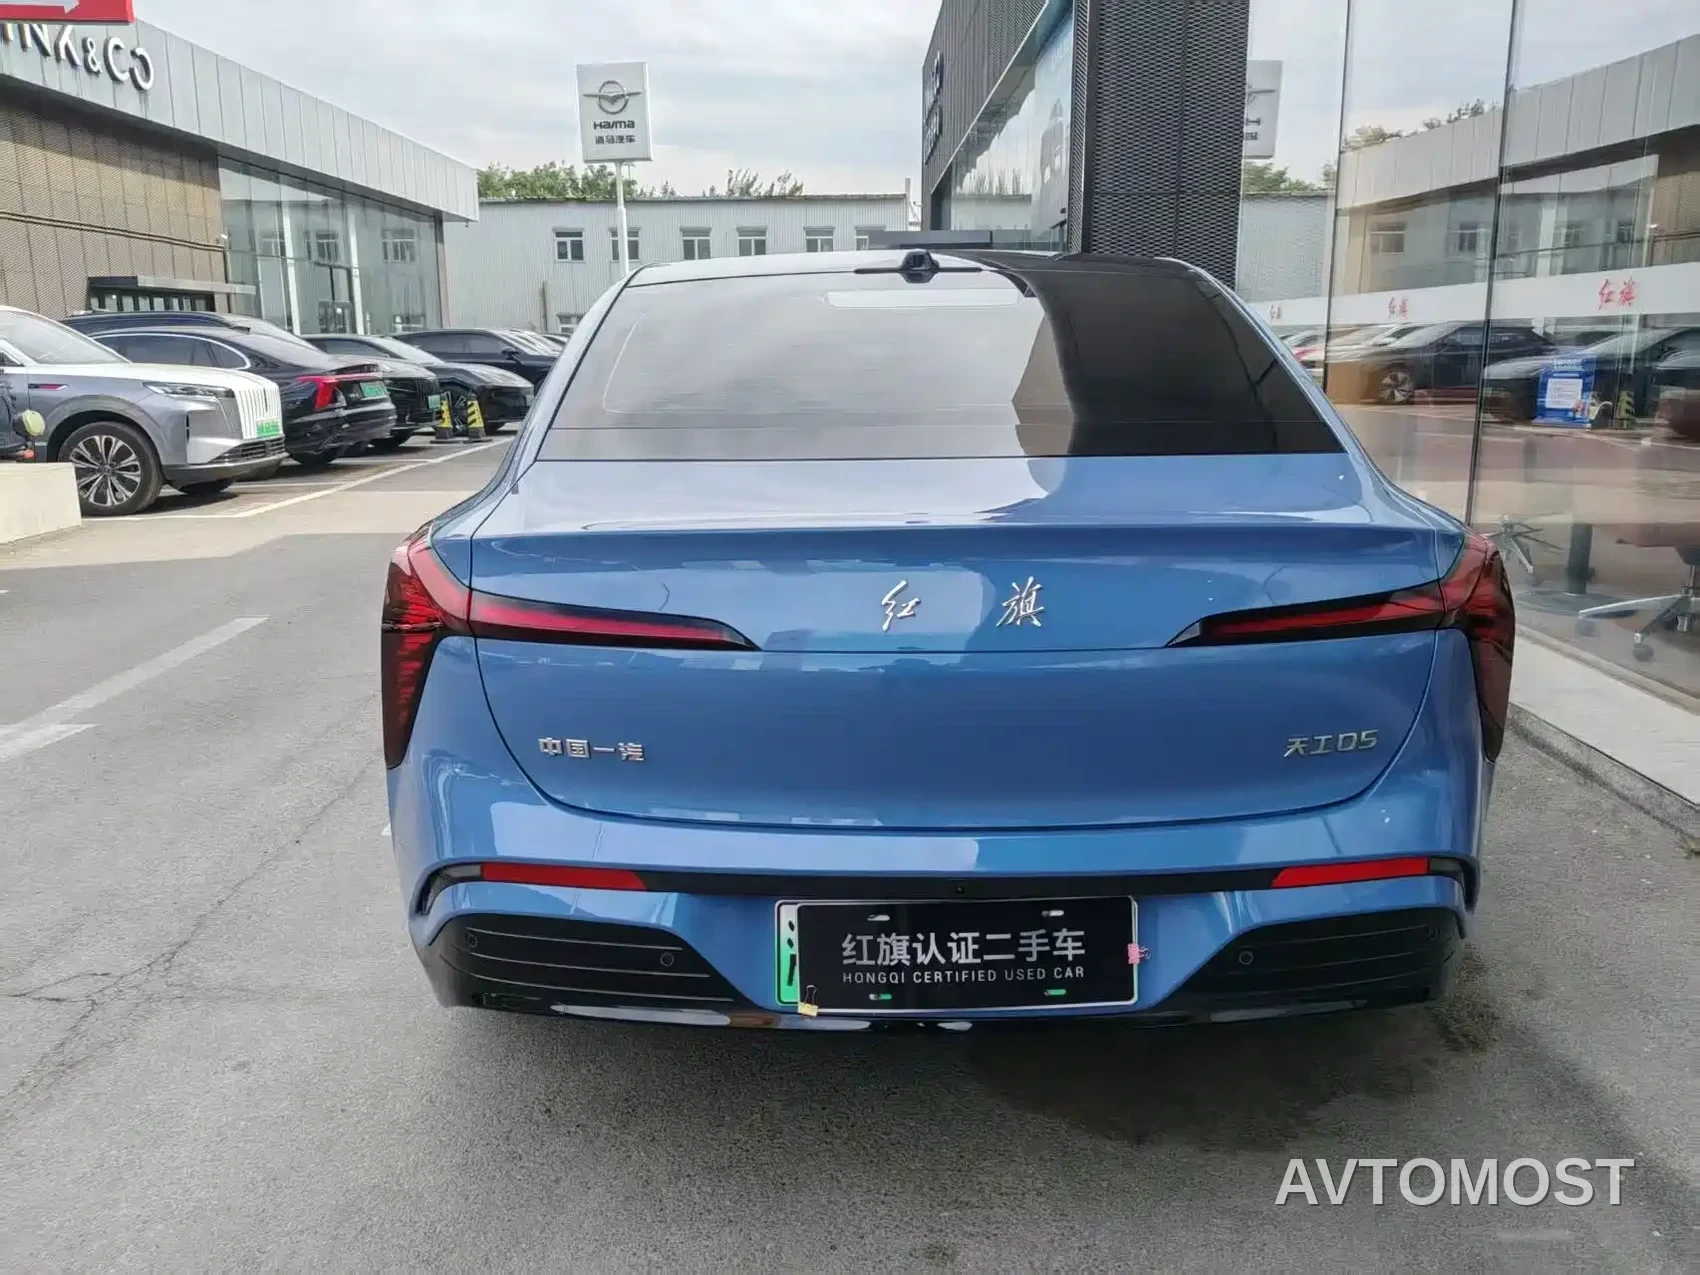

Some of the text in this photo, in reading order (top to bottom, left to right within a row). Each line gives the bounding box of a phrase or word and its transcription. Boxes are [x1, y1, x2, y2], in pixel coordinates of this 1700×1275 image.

[881, 575, 1045, 632] 红旗
[538, 737, 645, 762] 中国一汽
[841, 928, 1086, 967] 红旗认证二手车
[843, 966, 1085, 984] HONGQI CERTIFIED USED CAR
